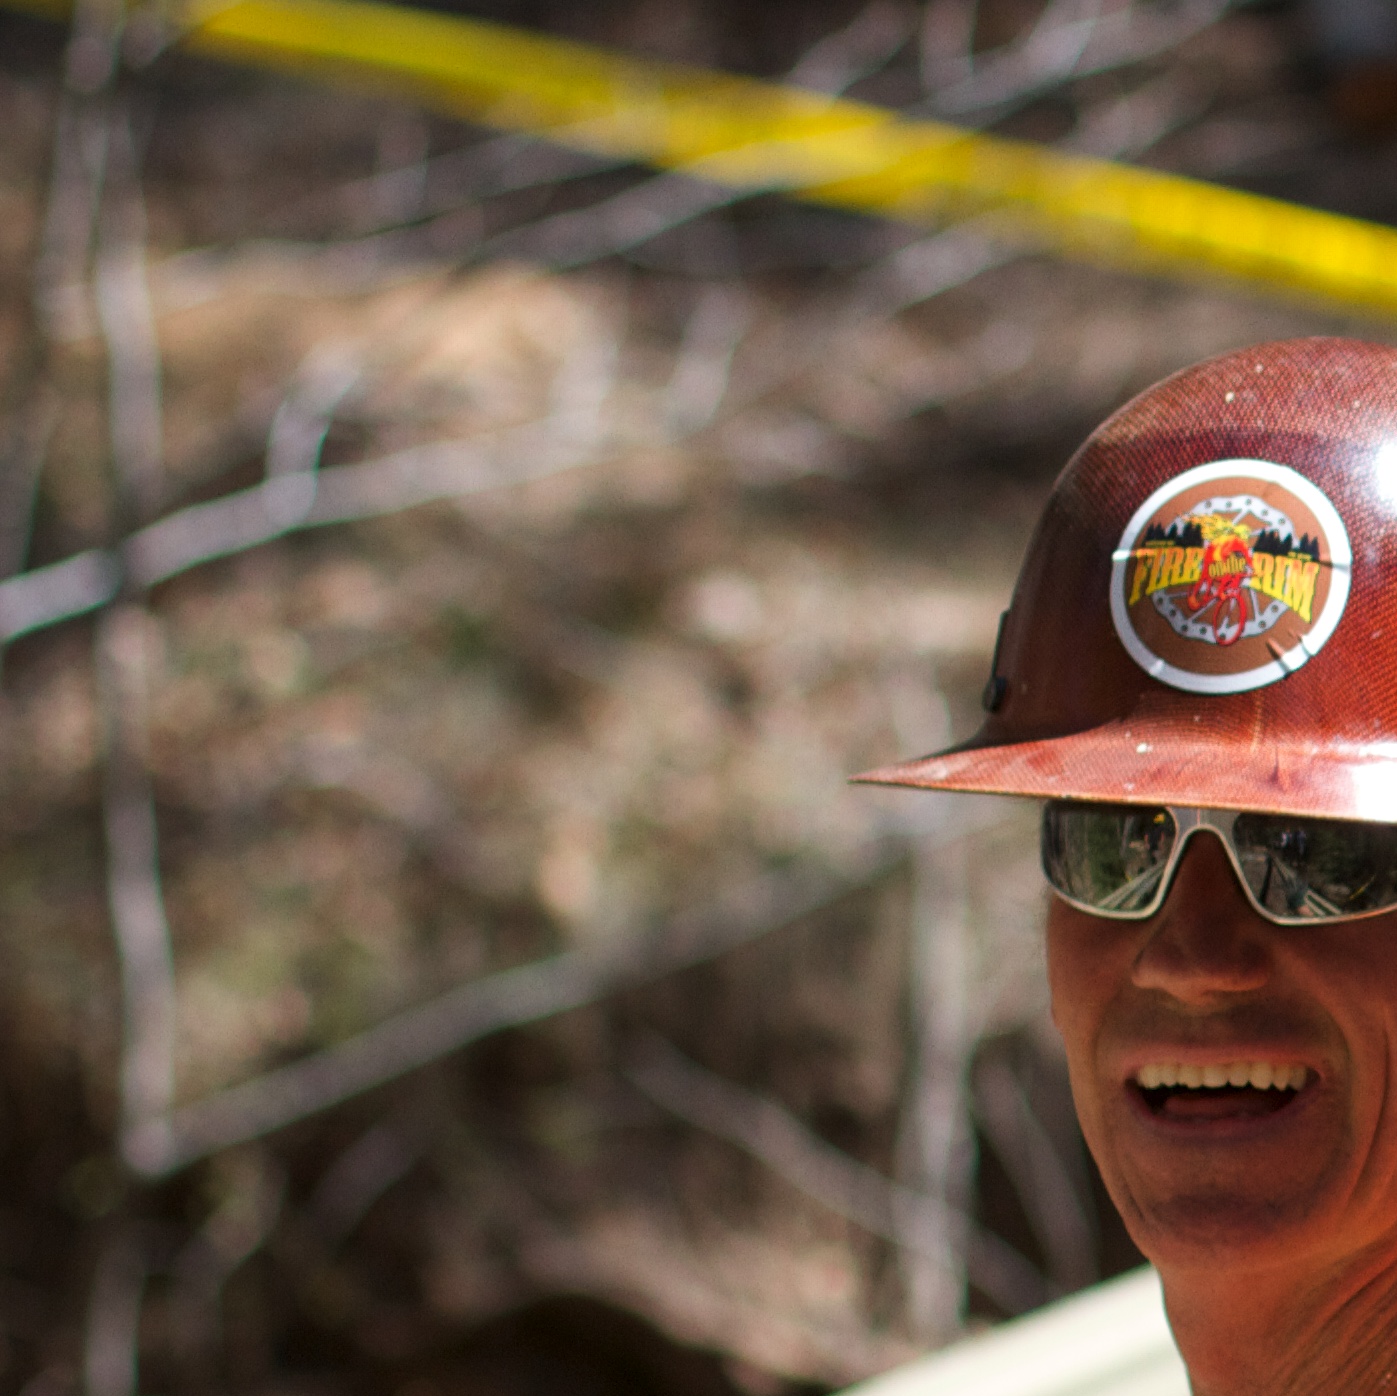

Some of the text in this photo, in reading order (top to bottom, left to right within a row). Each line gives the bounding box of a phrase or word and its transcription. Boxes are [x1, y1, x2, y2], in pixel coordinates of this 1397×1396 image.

[1129, 546, 1204, 606] FIRE
[1226, 554, 1246, 574] the
[1251, 552, 1320, 623] RIM
